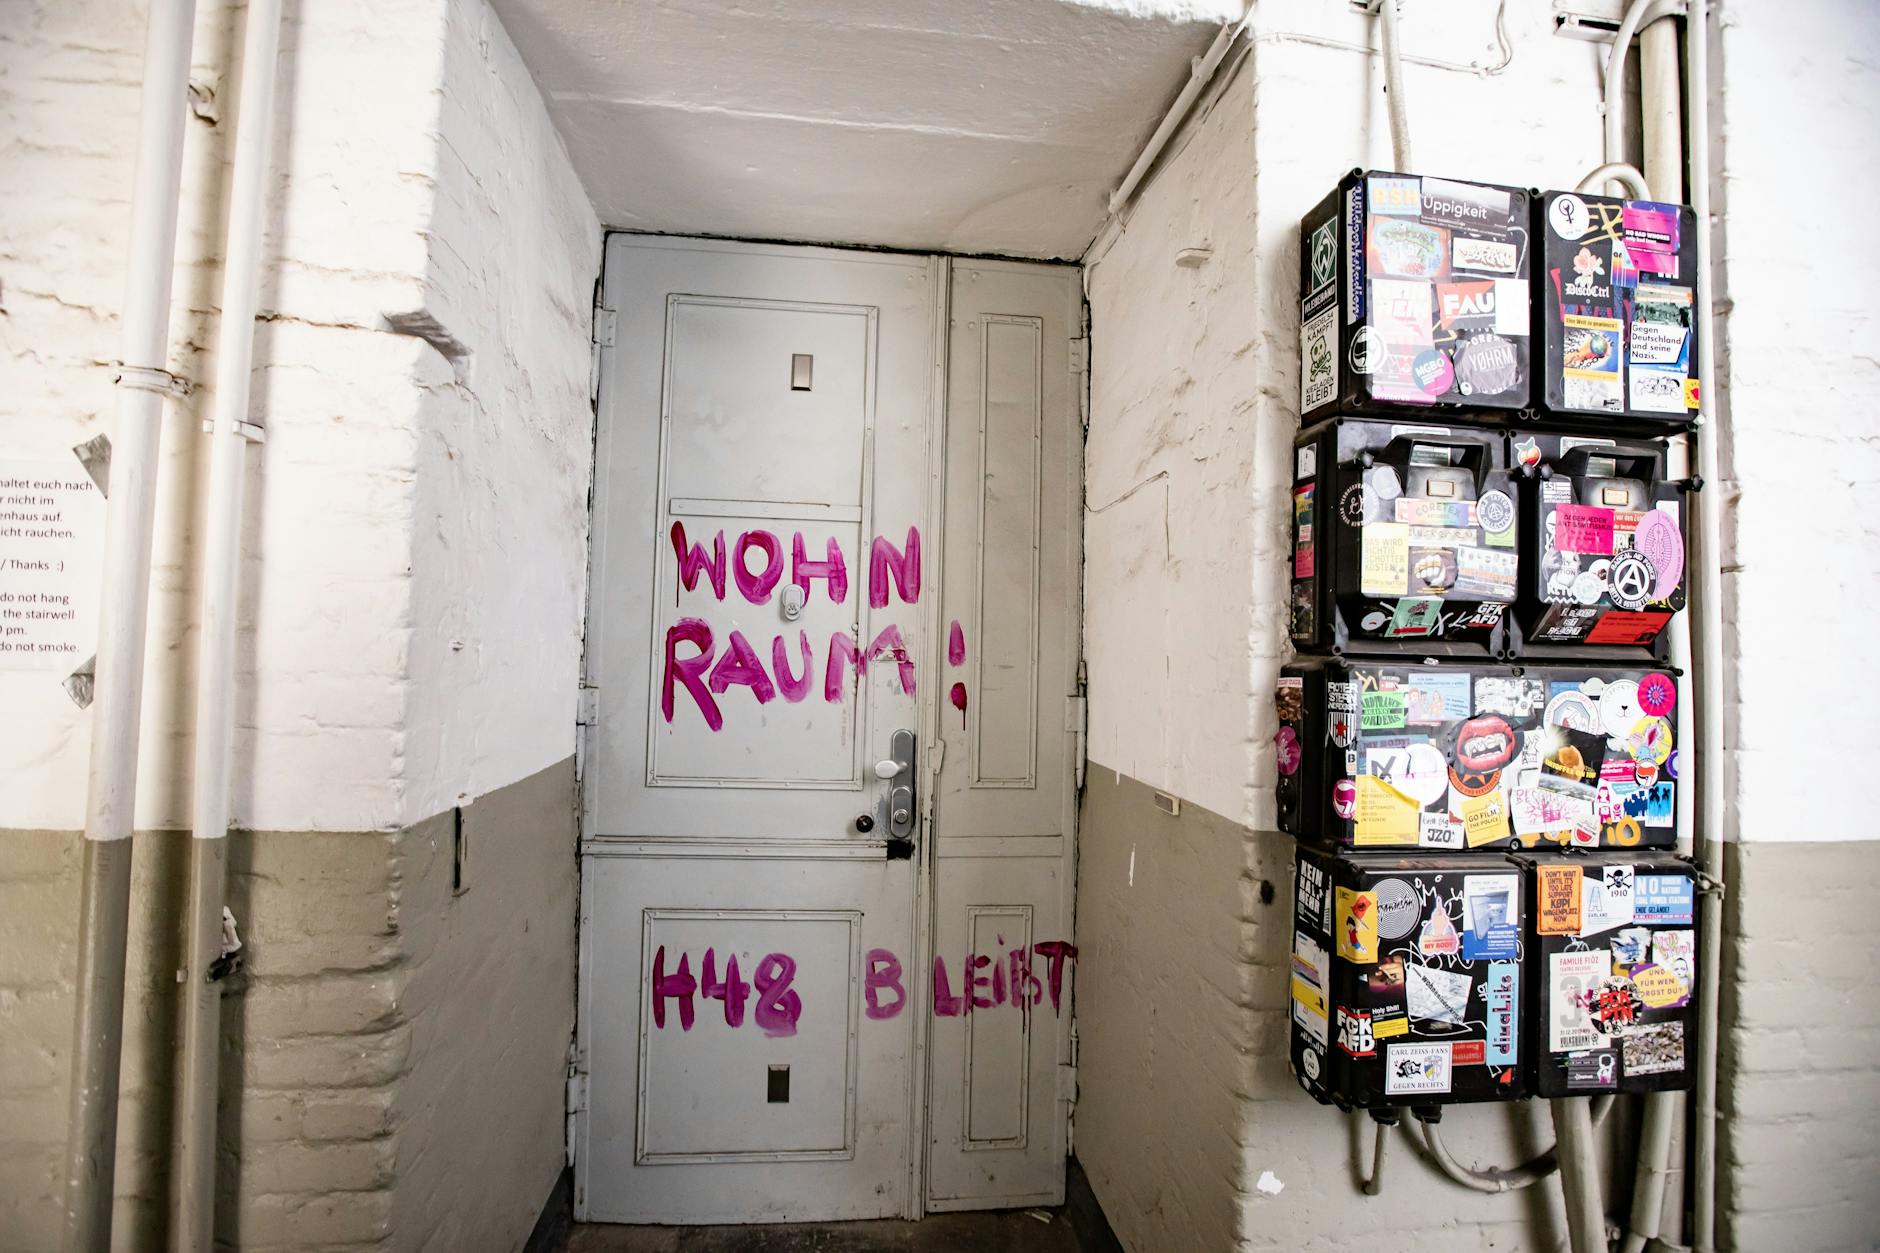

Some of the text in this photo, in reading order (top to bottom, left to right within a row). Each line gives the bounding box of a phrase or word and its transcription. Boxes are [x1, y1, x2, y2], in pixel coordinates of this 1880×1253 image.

[1423, 193, 1488, 220] Üppigkeit
[1443, 292, 1495, 315] FAU
[1307, 320, 1334, 342] KAMPFT
[1632, 325, 1659, 335] Gegen
[1632, 332, 1681, 345] Deutschland
[1632, 343, 1671, 353] und seine
[1632, 350, 1657, 360] Nazis.
[1306, 382, 1334, 406] BLEIBT
[34, 480, 61, 490] euch
[66, 482, 93, 491] nach
[7, 495, 54, 505] nicht im
[42, 512, 63, 522] auf.
[25, 528, 76, 539] rauchen.
[10, 559, 50, 571] Thanks
[670, 520, 921, 608] WOHN
[1610, 552, 1656, 580] RADICAL AID FORCE
[0, 592, 70, 606] do not hang
[3, 608, 75, 620] the stairwell
[6, 626, 28, 637] pm.
[15, 643, 34, 652] not
[38, 642, 80, 653] smoke.
[1468, 809, 1497, 822] GO FILM
[1301, 859, 1324, 888] KEIN
[1635, 877, 1660, 896] NO
[1611, 889, 1628, 898] 1910
[1298, 887, 1320, 914] MEHR
[1560, 957, 1583, 966] FAMILIE
[1648, 968, 1666, 976] UND
[1640, 977, 1675, 987] FÜR WEN
[651, 944, 802, 1038] H48
[1336, 1007, 1373, 1036] FCK
[1336, 1027, 1376, 1052] AFD
[1391, 1048, 1409, 1056] CARL
[1393, 1080, 1444, 1090] GEGEN RECHTS
